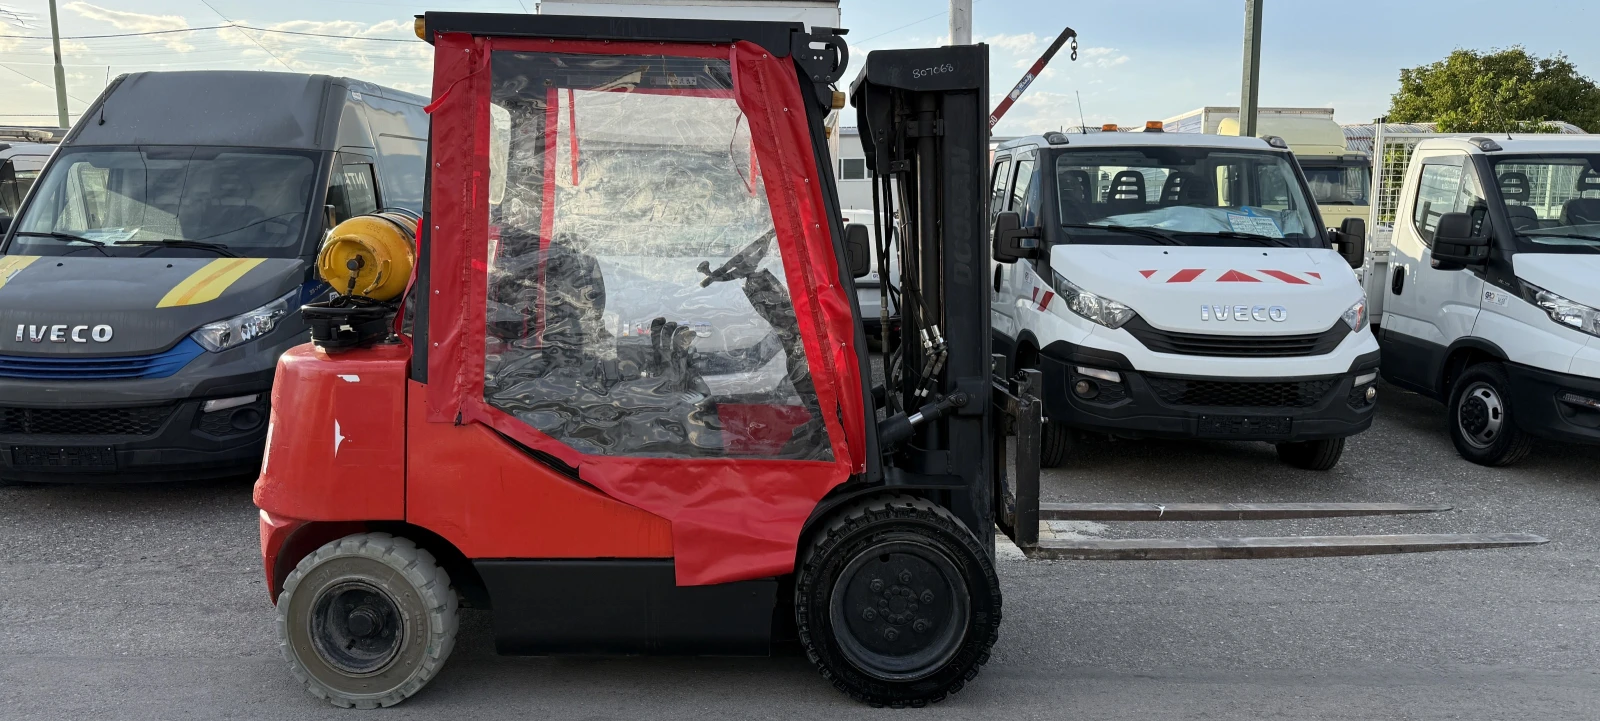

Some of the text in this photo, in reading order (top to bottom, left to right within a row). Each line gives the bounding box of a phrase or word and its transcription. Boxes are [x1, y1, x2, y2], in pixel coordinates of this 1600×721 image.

[912, 63, 954, 79] 807068
[1200, 304, 1287, 323] IVECO
[15, 324, 113, 343] IVECO
